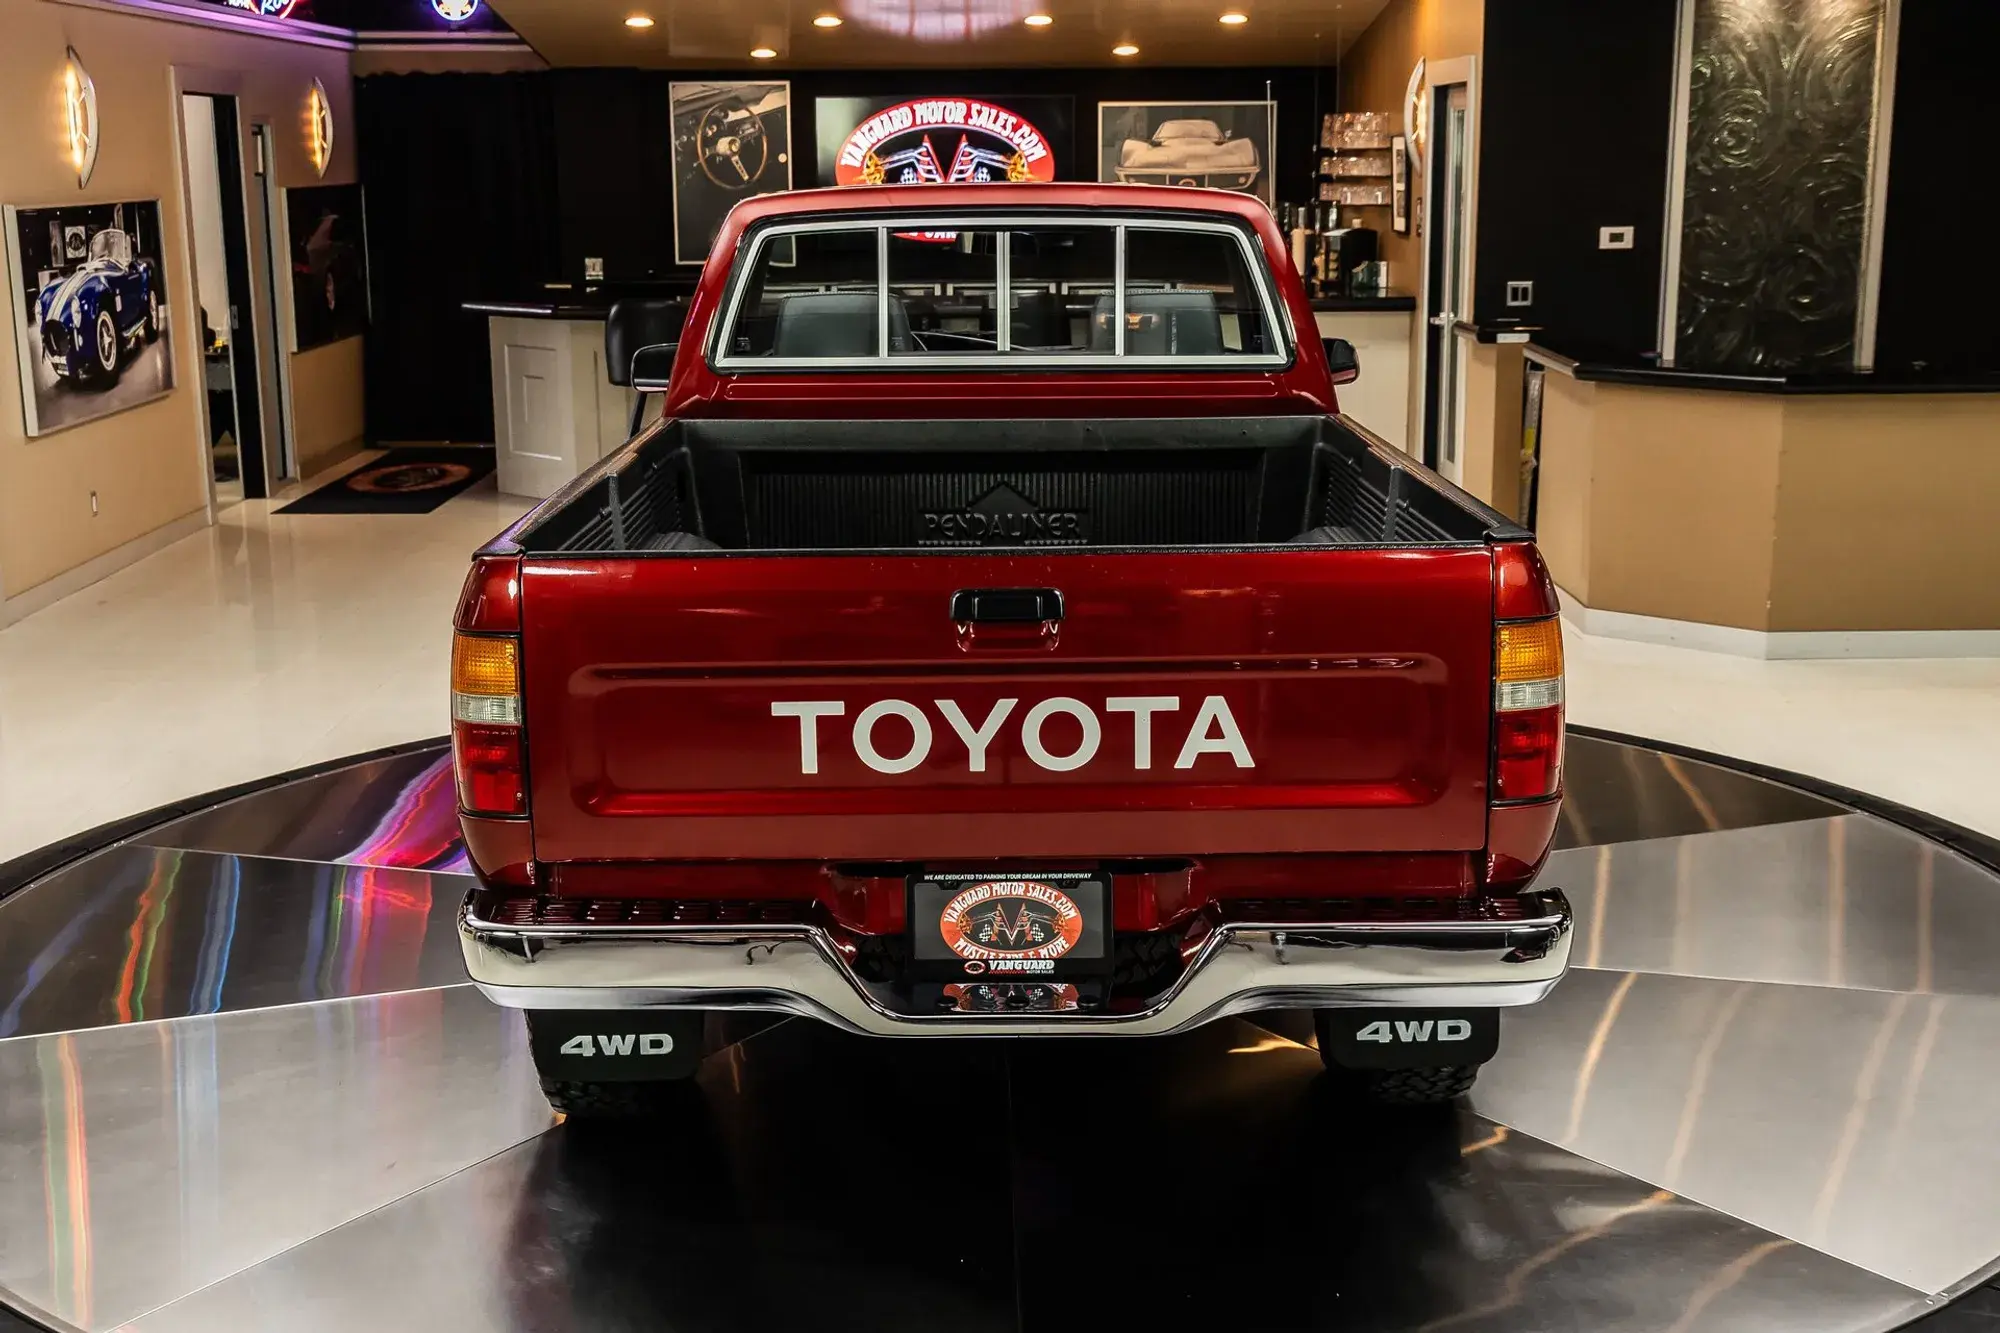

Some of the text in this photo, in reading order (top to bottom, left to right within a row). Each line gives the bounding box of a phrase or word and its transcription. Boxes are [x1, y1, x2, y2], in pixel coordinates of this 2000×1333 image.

[840, 101, 1047, 168] VANGUARD MOTOR SALES.COM
[771, 696, 1256, 774] TOYOTA
[944, 882, 1077, 923] VANGUARD MOTOR SALES.COM
[1038, 935, 1070, 959] MORE
[988, 960, 1055, 970] VANGUARD
[1356, 1019, 1472, 1043] 4WD
[560, 1033, 674, 1057] 4WD
